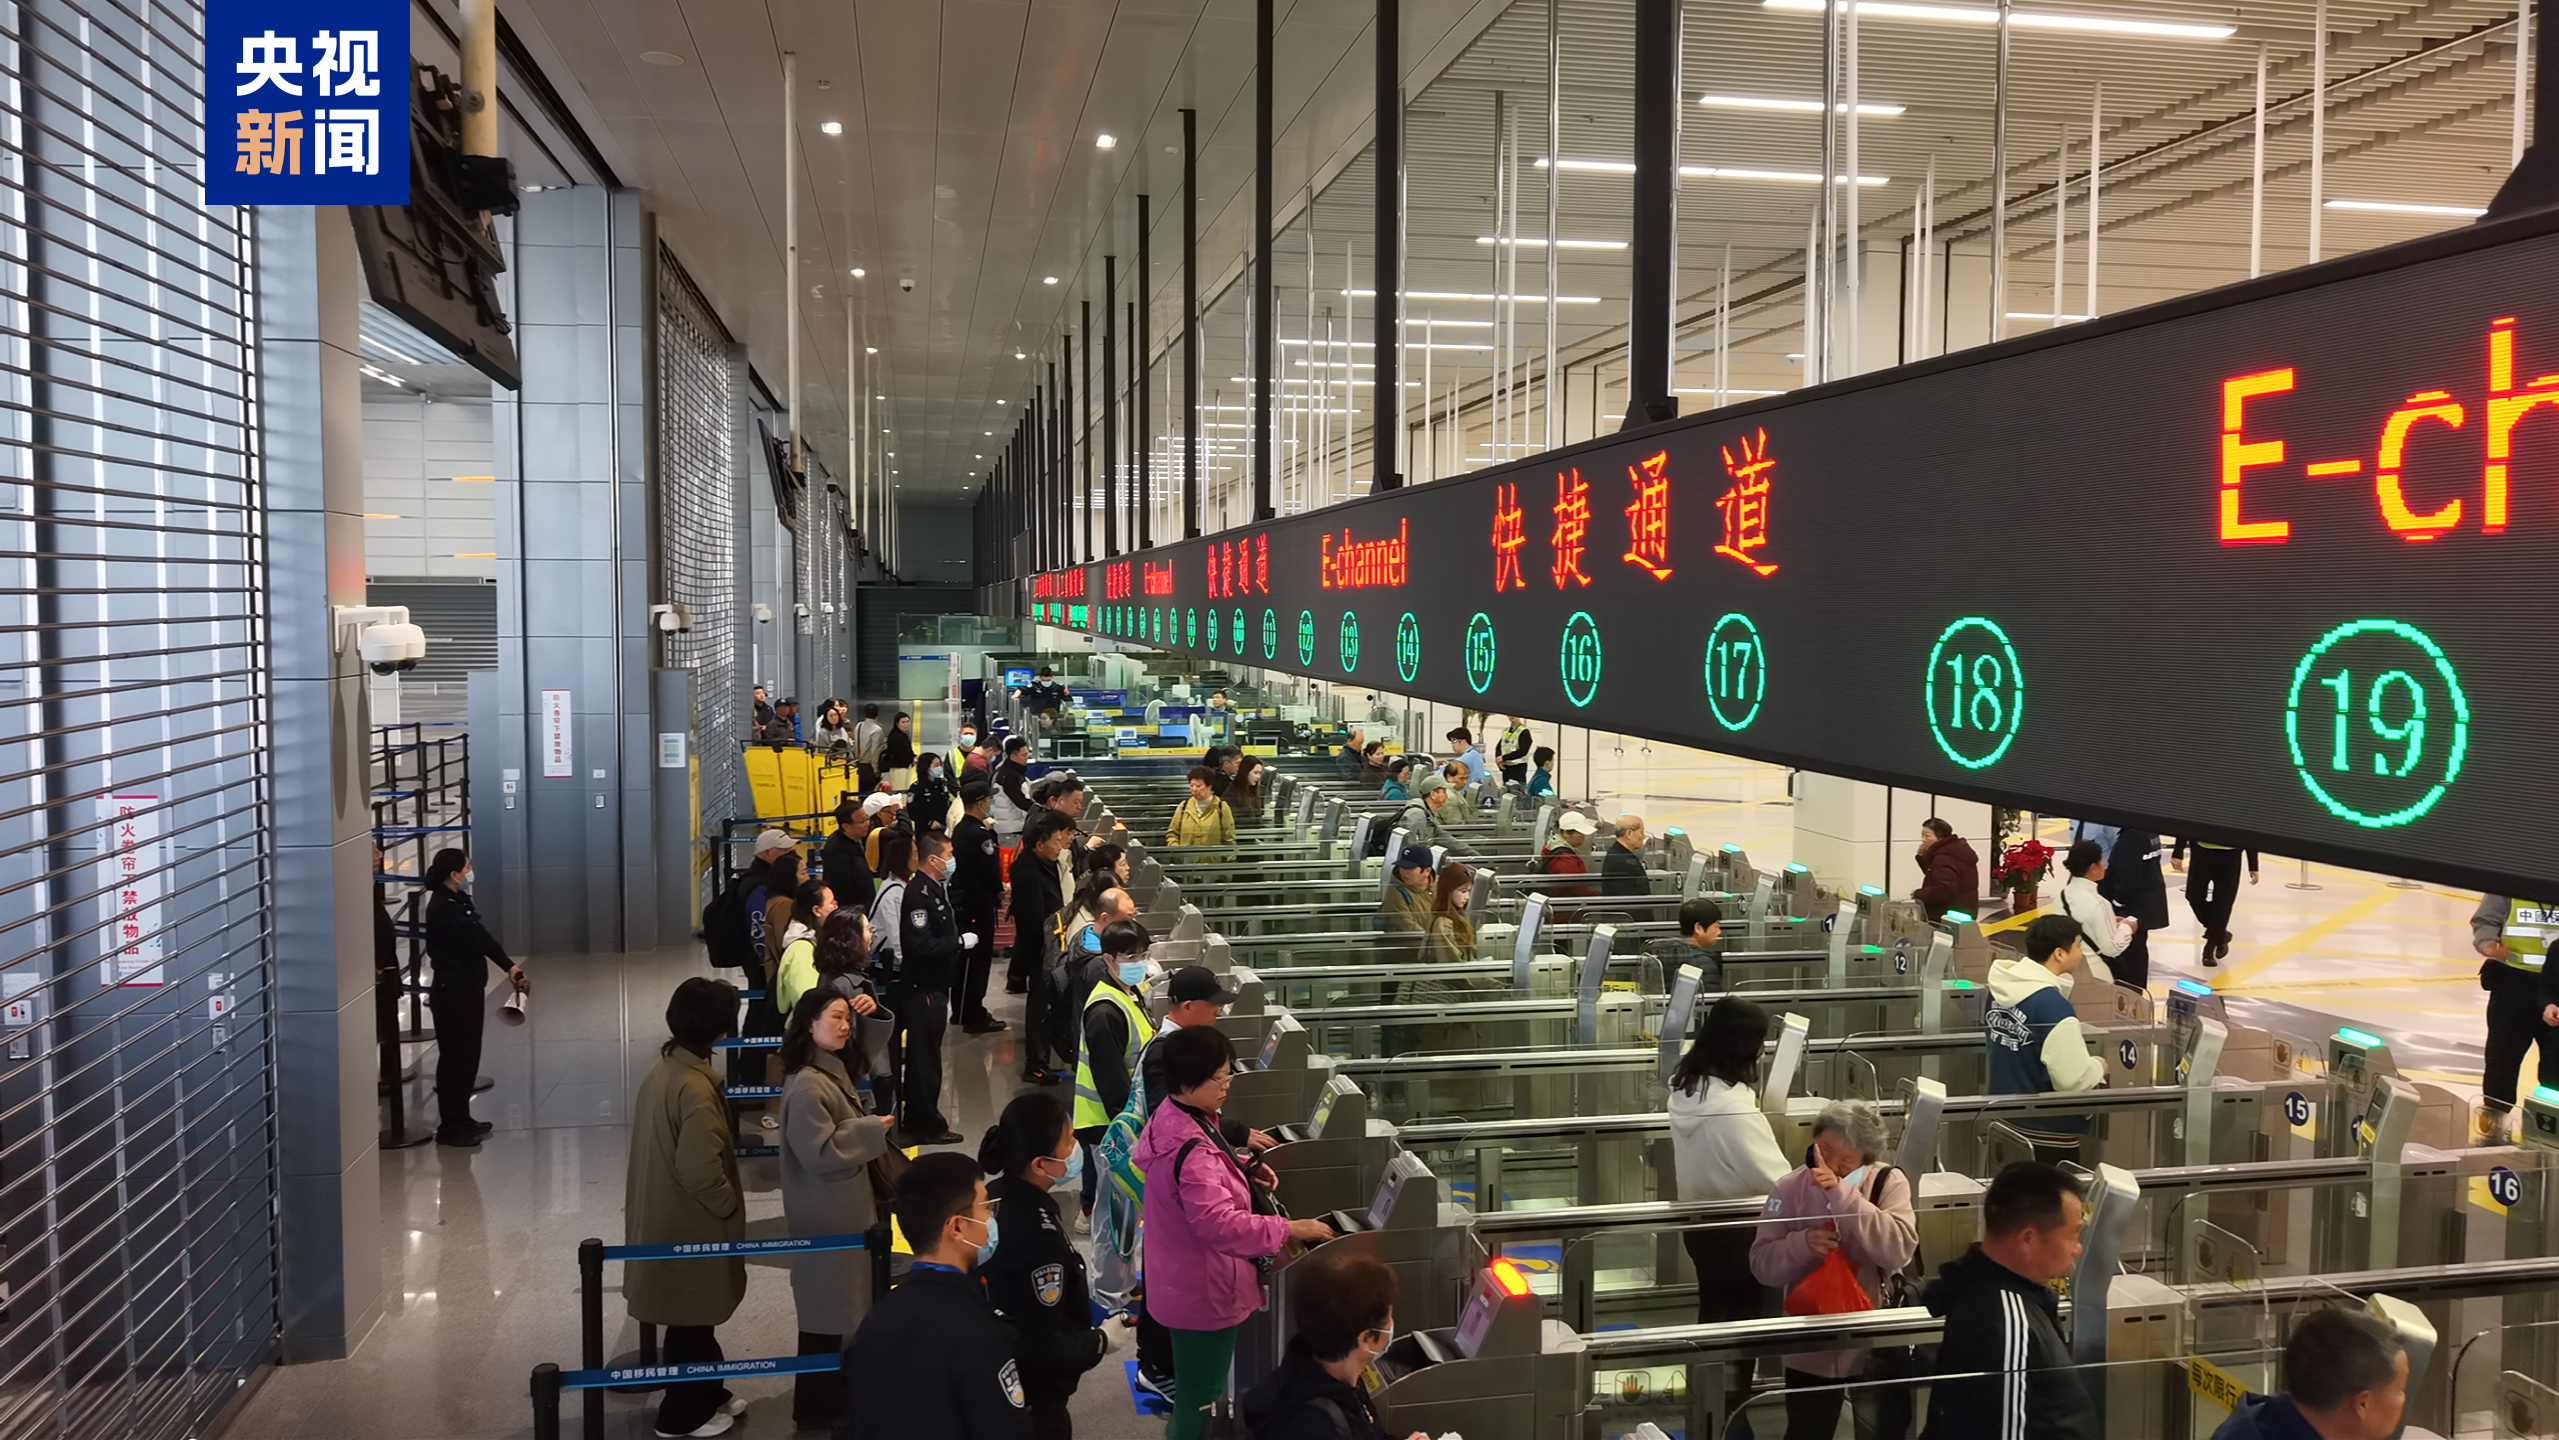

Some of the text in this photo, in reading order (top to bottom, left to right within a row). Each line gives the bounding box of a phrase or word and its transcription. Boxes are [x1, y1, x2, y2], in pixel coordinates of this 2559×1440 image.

[1491, 426, 1779, 592] 快捷通道
[1322, 517, 1408, 589] E-channel
[1207, 532, 1269, 599] 快捷通道
[1401, 629, 1415, 665] 14
[1471, 632, 1490, 672] 15
[1569, 634, 1592, 682] 16
[1716, 641, 1752, 700] 17
[1946, 653, 2004, 733] 18
[2321, 668, 2427, 777] 19
[1483, 797, 1492, 808] 4
[1894, 955, 1907, 971] 12
[2120, 1044, 2138, 1063] 14
[2285, 1097, 2308, 1121] 15
[2490, 1172, 2519, 1201] 16
[1768, 1198, 1783, 1212] 27
[673, 1239, 811, 1253] 中国移民管理 CHINA IMMIGRATION
[611, 1361, 776, 1380] 中国移民管理 CHINA IMMIGRATION
